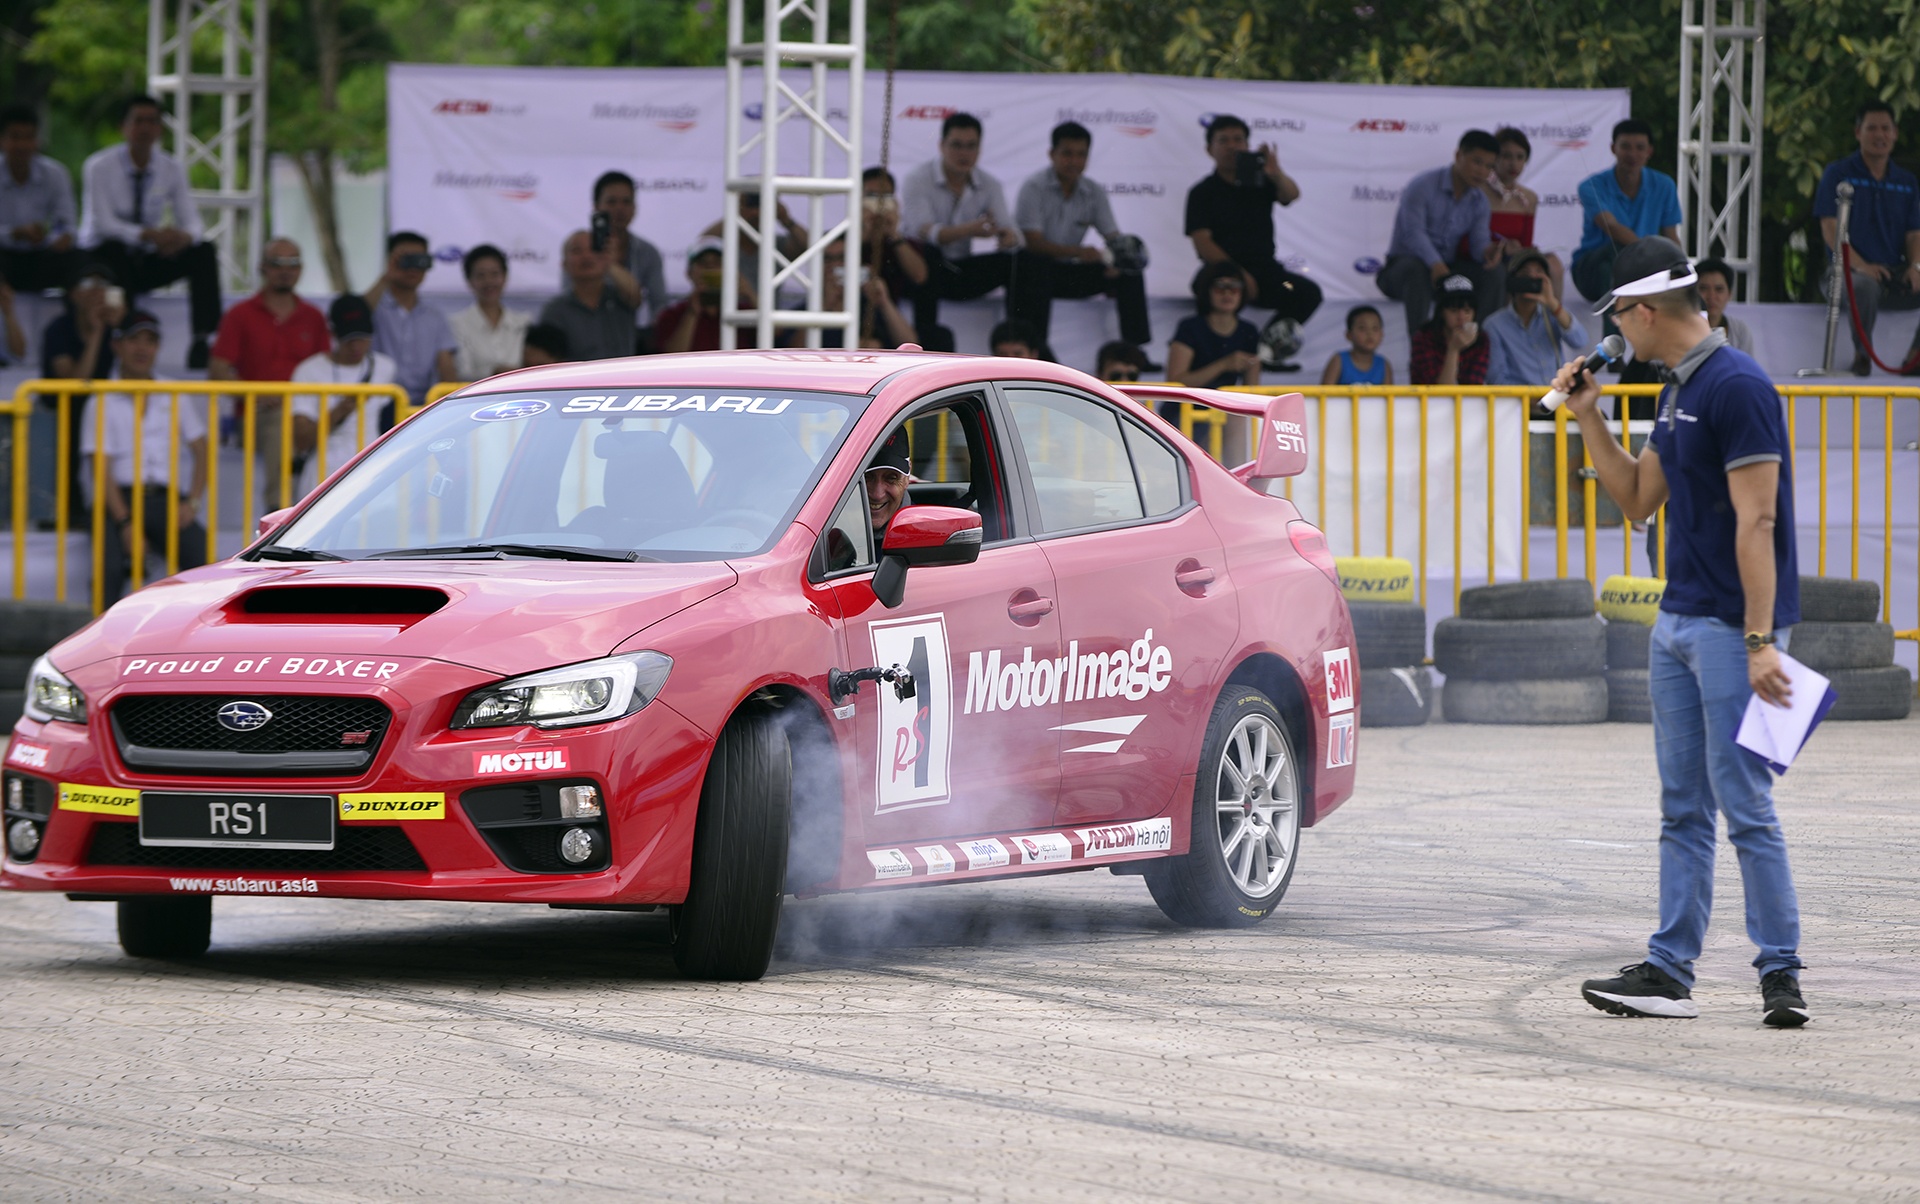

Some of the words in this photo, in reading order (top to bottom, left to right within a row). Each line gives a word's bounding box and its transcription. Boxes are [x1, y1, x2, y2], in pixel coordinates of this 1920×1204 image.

[1101, 183, 1166, 196] UBARU
[561, 395, 794, 416] SUBARU
[1271, 419, 1303, 436] WRX
[1276, 433, 1306, 454] STI
[1341, 574, 1410, 593] UNLOP
[1601, 590, 1661, 605] DUNLO
[123, 656, 225, 677] Proud
[233, 656, 273, 674] of
[279, 657, 400, 680] BOXER
[963, 627, 1173, 715] MotorImage
[1328, 658, 1351, 701] 3M
[477, 750, 567, 774] MOTUL
[70, 793, 137, 807] DUNLOP
[357, 800, 440, 812] DUNLOP
[208, 802, 268, 835] RS1
[1152, 824, 1170, 849] nội
[170, 876, 319, 893] www.subaru.asia
